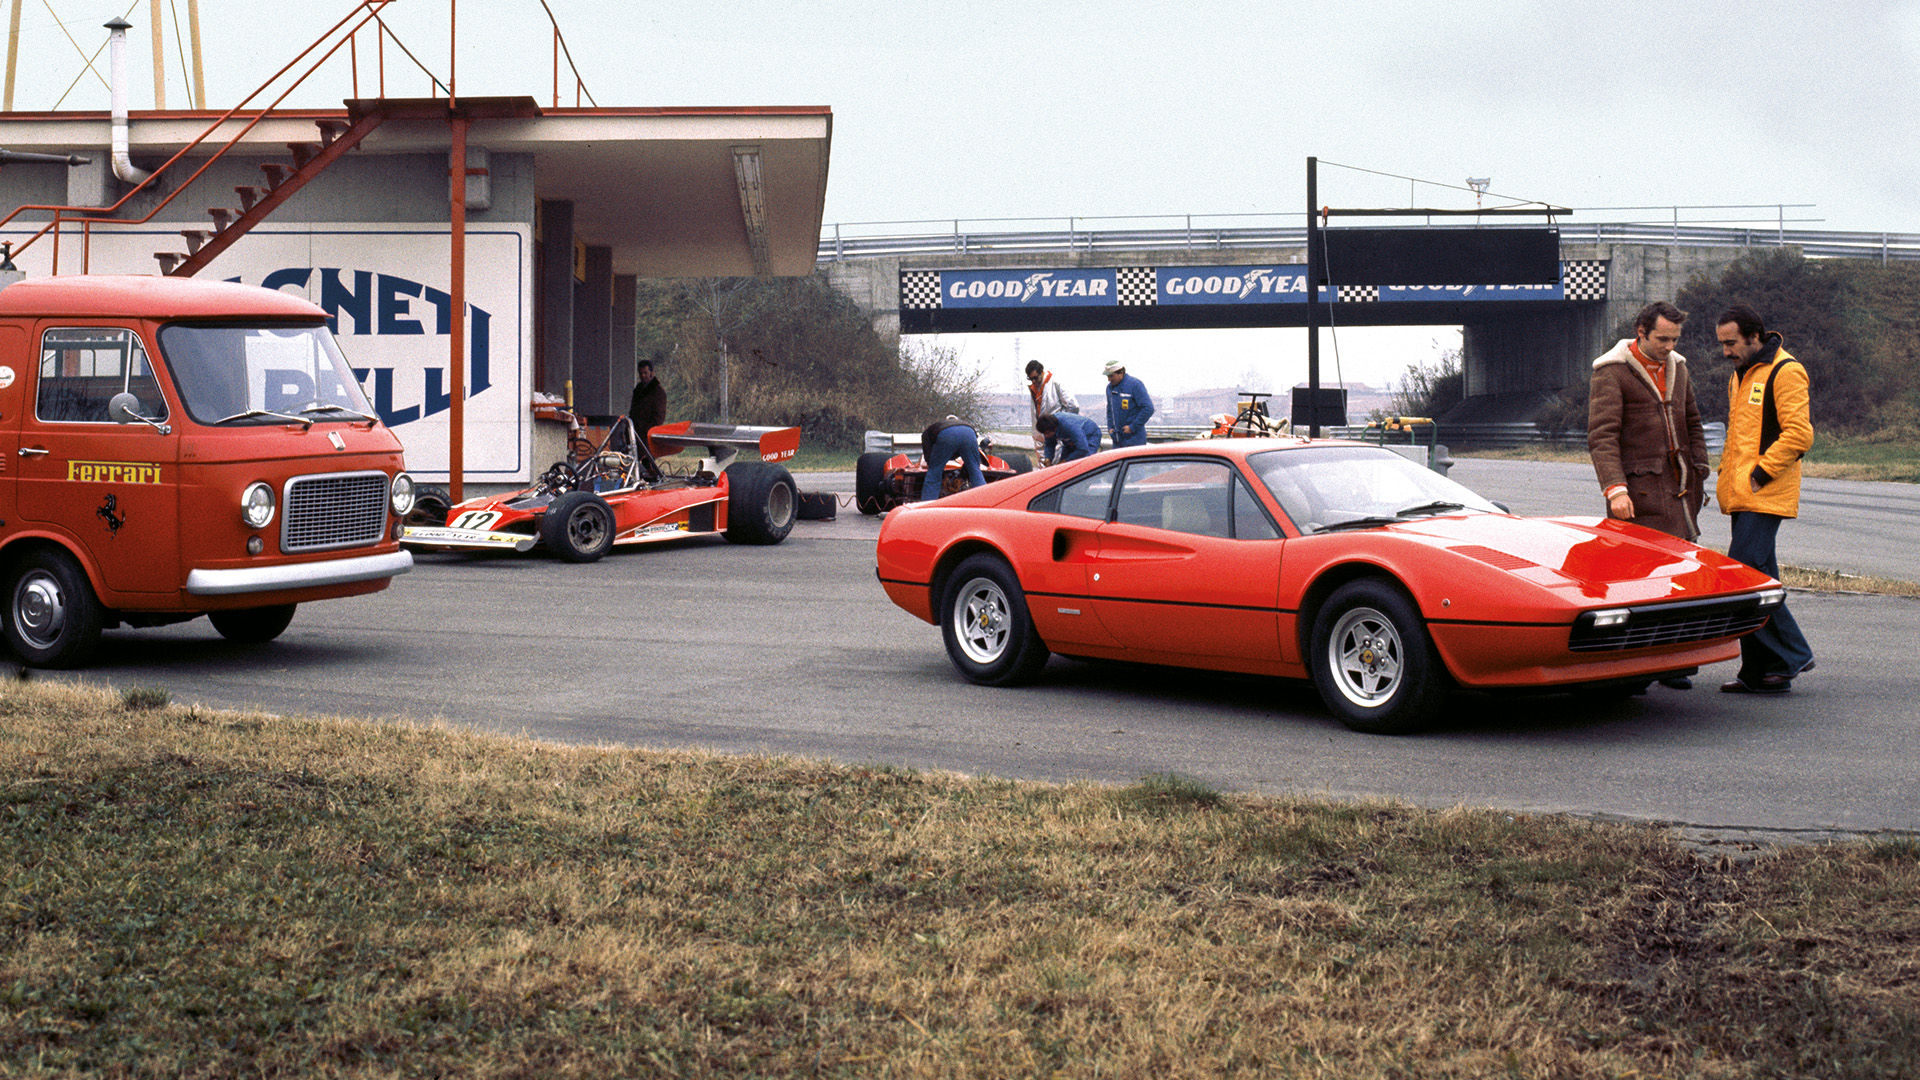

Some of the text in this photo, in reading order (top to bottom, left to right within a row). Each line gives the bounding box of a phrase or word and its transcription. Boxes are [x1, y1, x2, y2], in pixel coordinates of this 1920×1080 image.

[950, 279, 1109, 298] GOOD YEAR
[1165, 276, 1327, 295] GOOD YEA
[66, 460, 162, 485] Ferrari
[459, 512, 495, 530] 12
